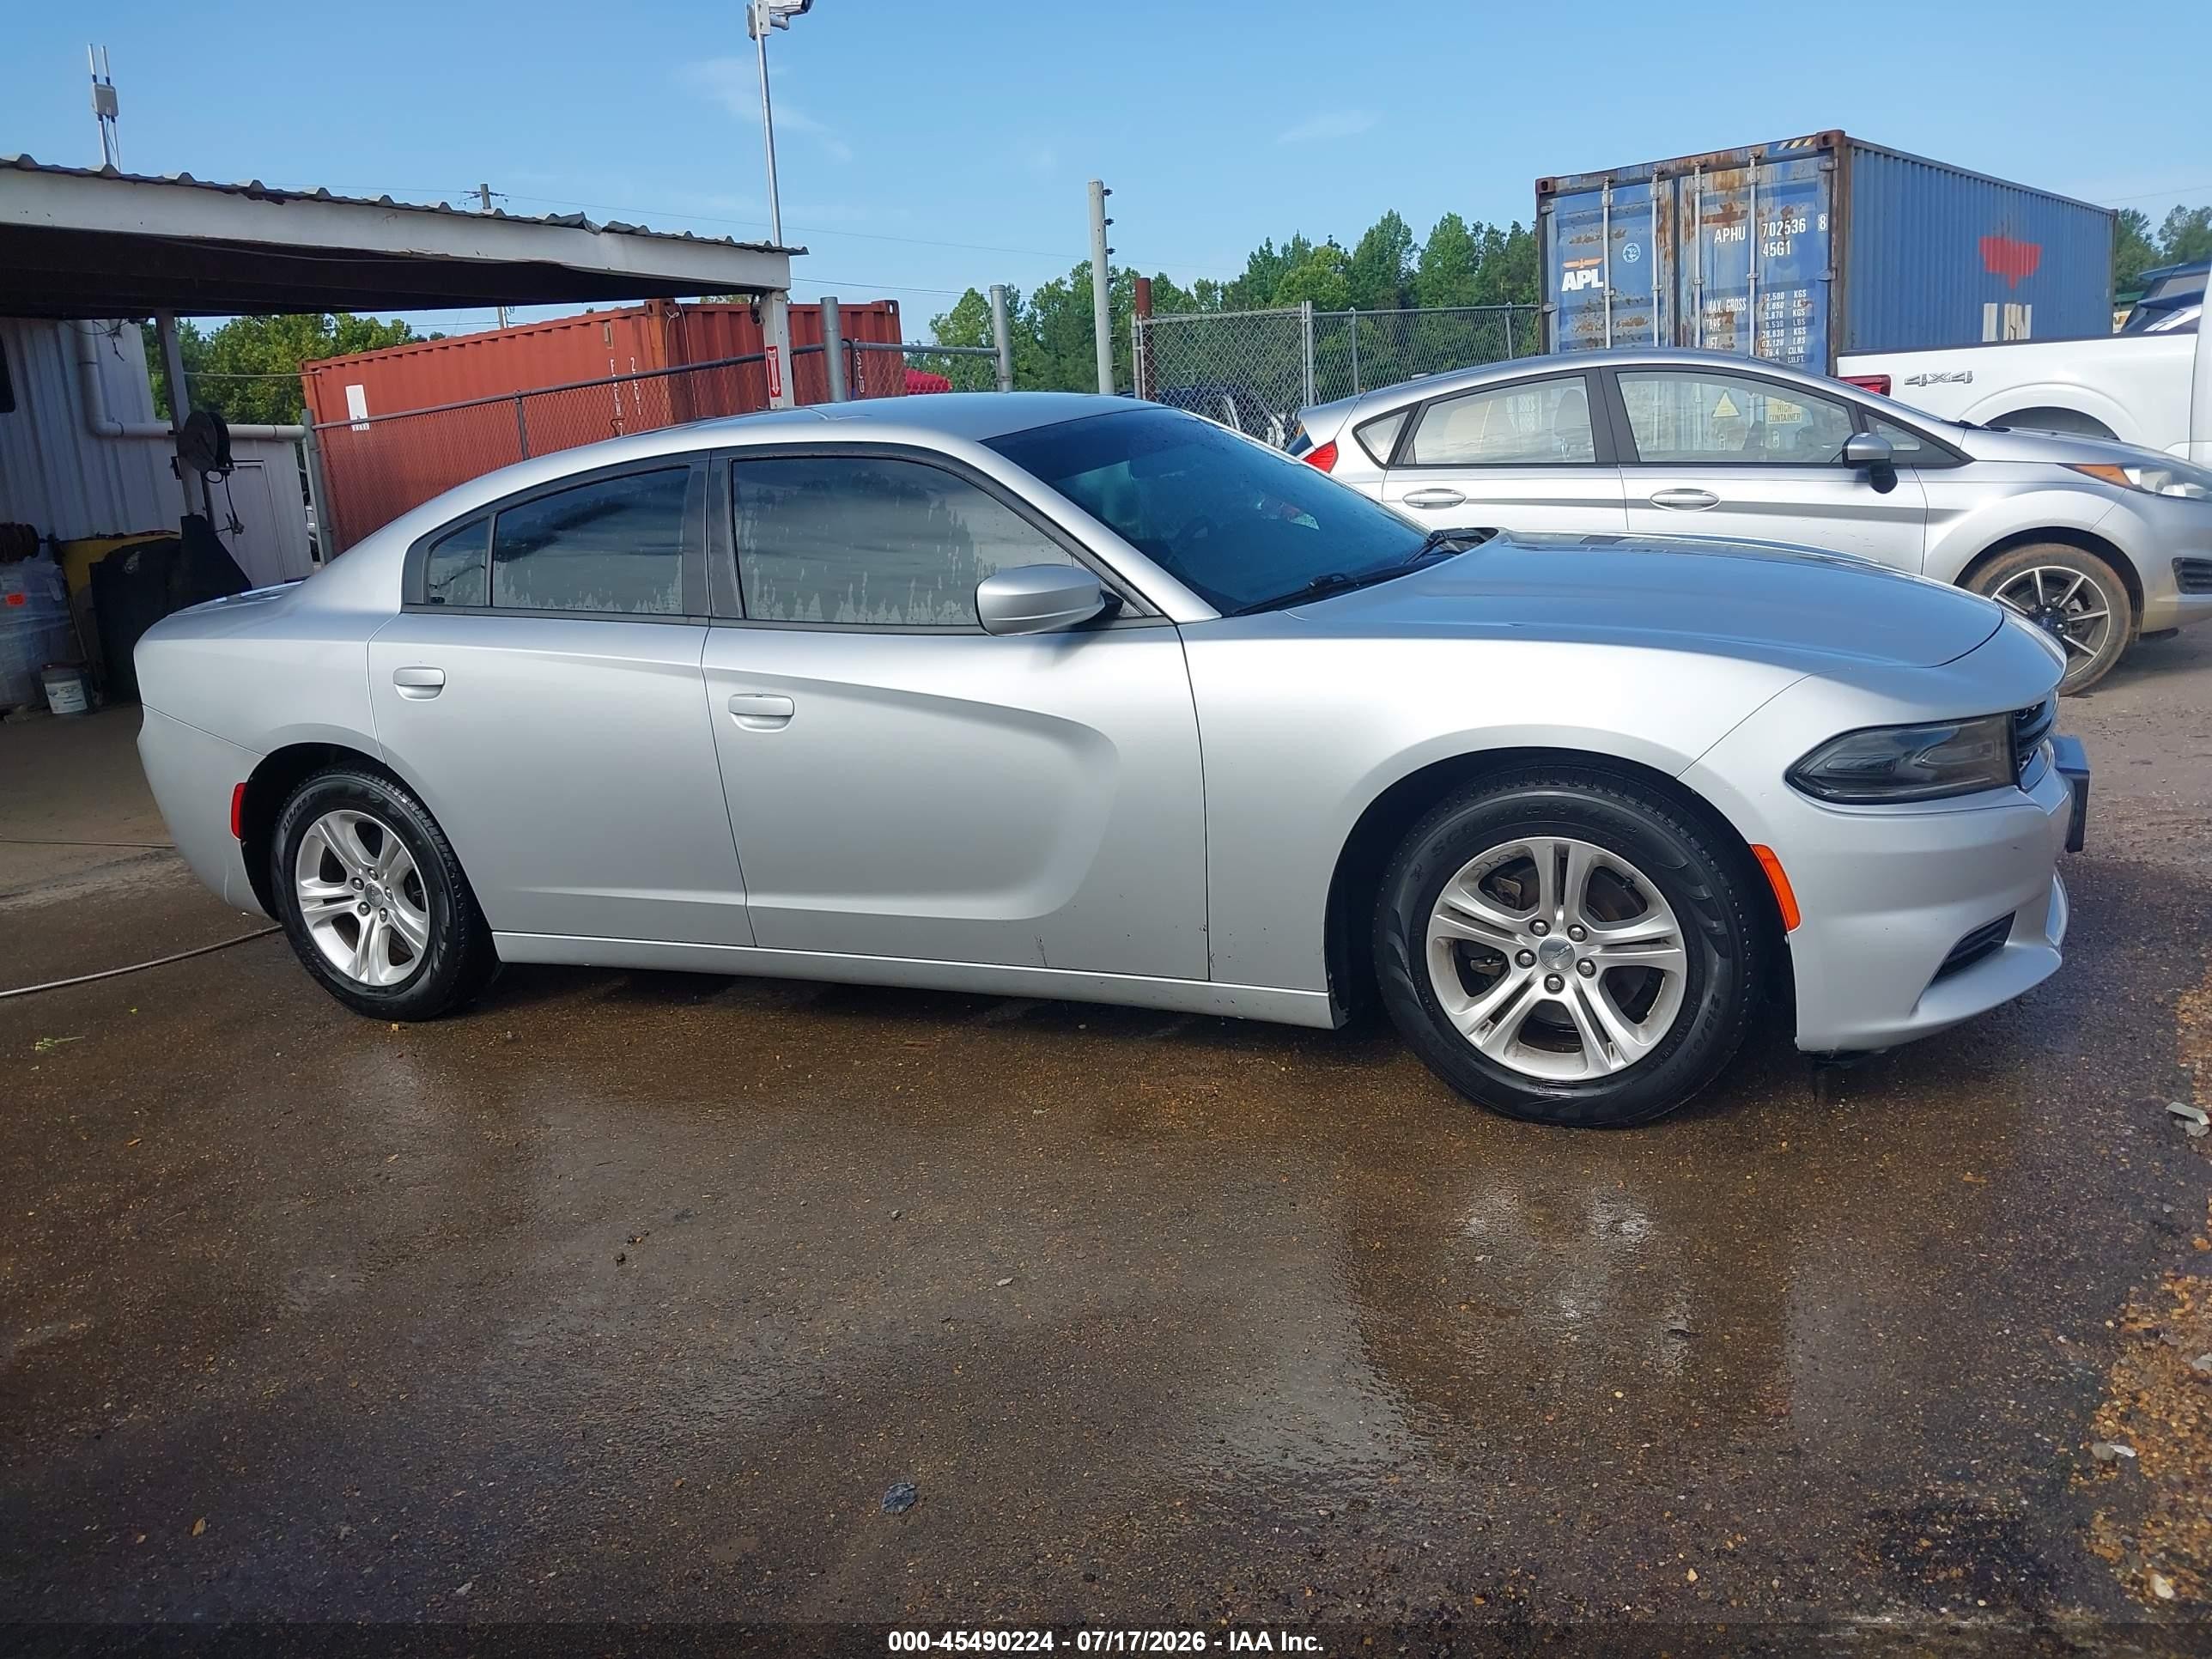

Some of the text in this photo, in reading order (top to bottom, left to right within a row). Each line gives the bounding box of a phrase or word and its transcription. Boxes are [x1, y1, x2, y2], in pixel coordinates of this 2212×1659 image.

[1714, 215, 1827, 244] APHU 702536 8
[1762, 240, 1790, 258] 45G1
[1561, 268, 1604, 292] APL
[1726, 297, 1747, 313] GROSS
[1794, 289, 1807, 299] KGS
[1705, 317, 1722, 332] TARE
[1792, 308, 1806, 318] KGS
[1793, 326, 1807, 336] KGS
[1769, 413, 1801, 422] CONTAINER
